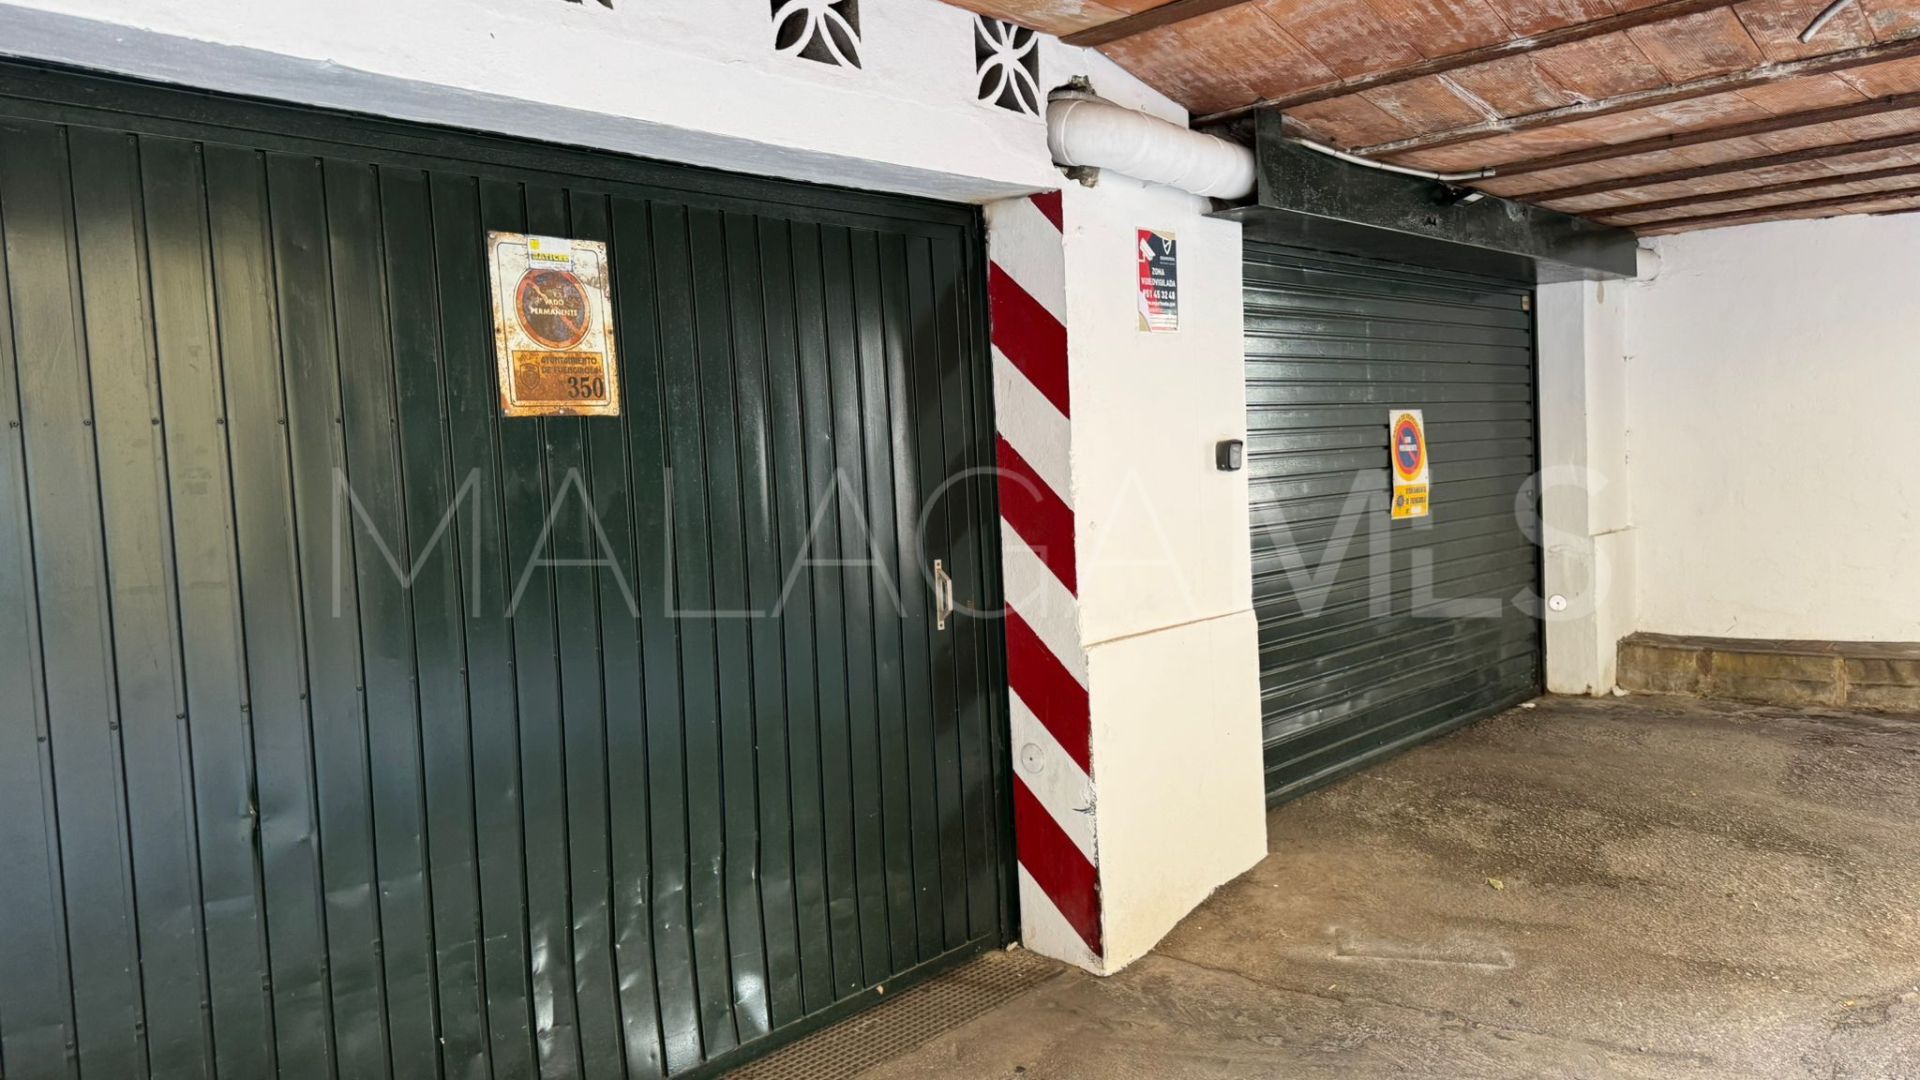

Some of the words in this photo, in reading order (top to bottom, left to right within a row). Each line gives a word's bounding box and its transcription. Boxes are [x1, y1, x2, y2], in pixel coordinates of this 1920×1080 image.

[1152, 267, 1165, 275] ZONA
[1141, 277, 1176, 287] VIDEOVIGILADA
[545, 298, 564, 306] VADO
[530, 307, 577, 316] PERMANENTE
[541, 356, 597, 365] AYUNTAMIENTO
[567, 376, 604, 399] 350
